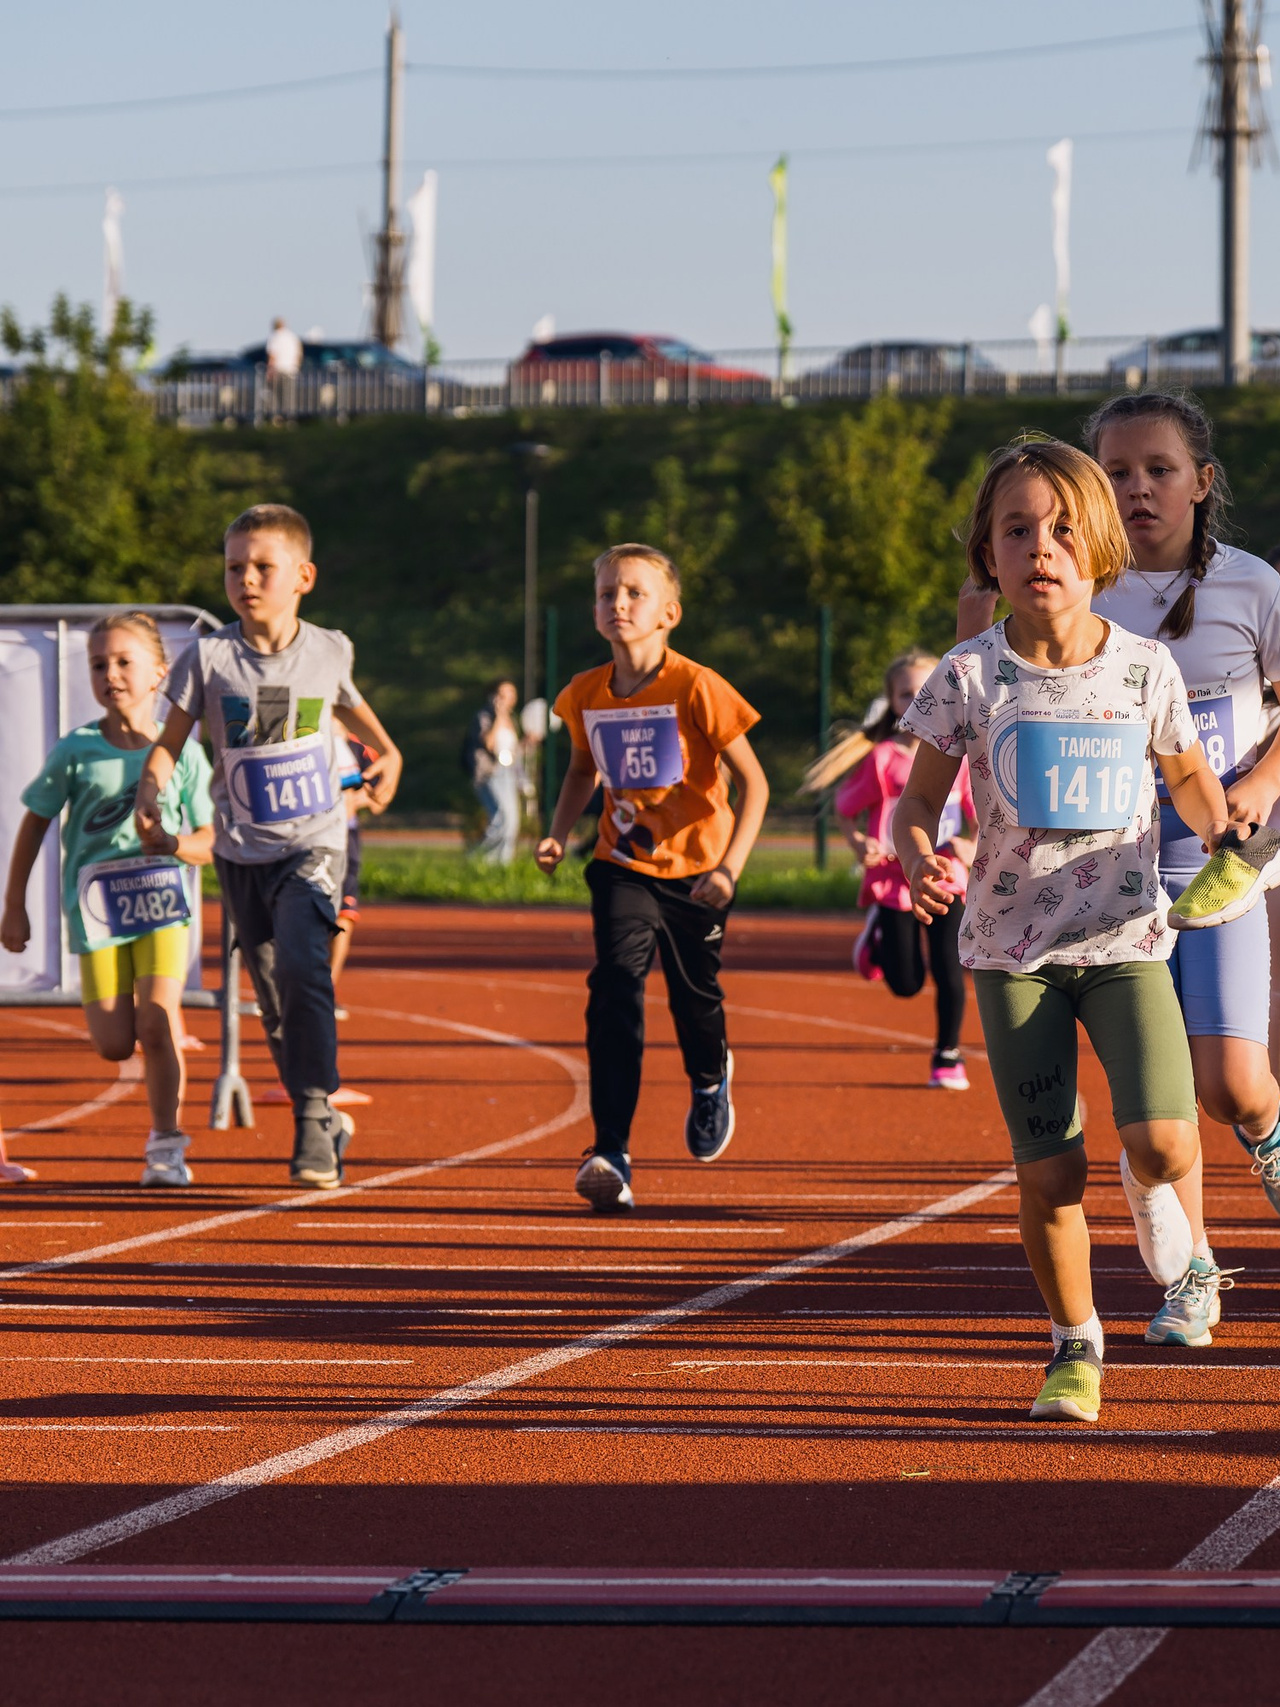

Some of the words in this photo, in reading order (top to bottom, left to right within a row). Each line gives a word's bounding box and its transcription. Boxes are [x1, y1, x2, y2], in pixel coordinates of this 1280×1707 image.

[1197, 688, 1211, 697] Пэй
[1114, 711, 1130, 719] Пэй
[621, 727, 656, 743] МАКАР
[1058, 736, 1122, 759] ТАИСИЯ
[263, 753, 316, 778] ТИМОФЕЙ
[625, 746, 657, 779] 55
[264, 771, 325, 813] 1411
[1044, 764, 1134, 814] 1416
[110, 870, 179, 893] АЛЕКСАНДРА
[117, 888, 182, 926] 2482
[1018, 1064, 1065, 1103] girl
[1026, 1112, 1075, 1138] Boss
